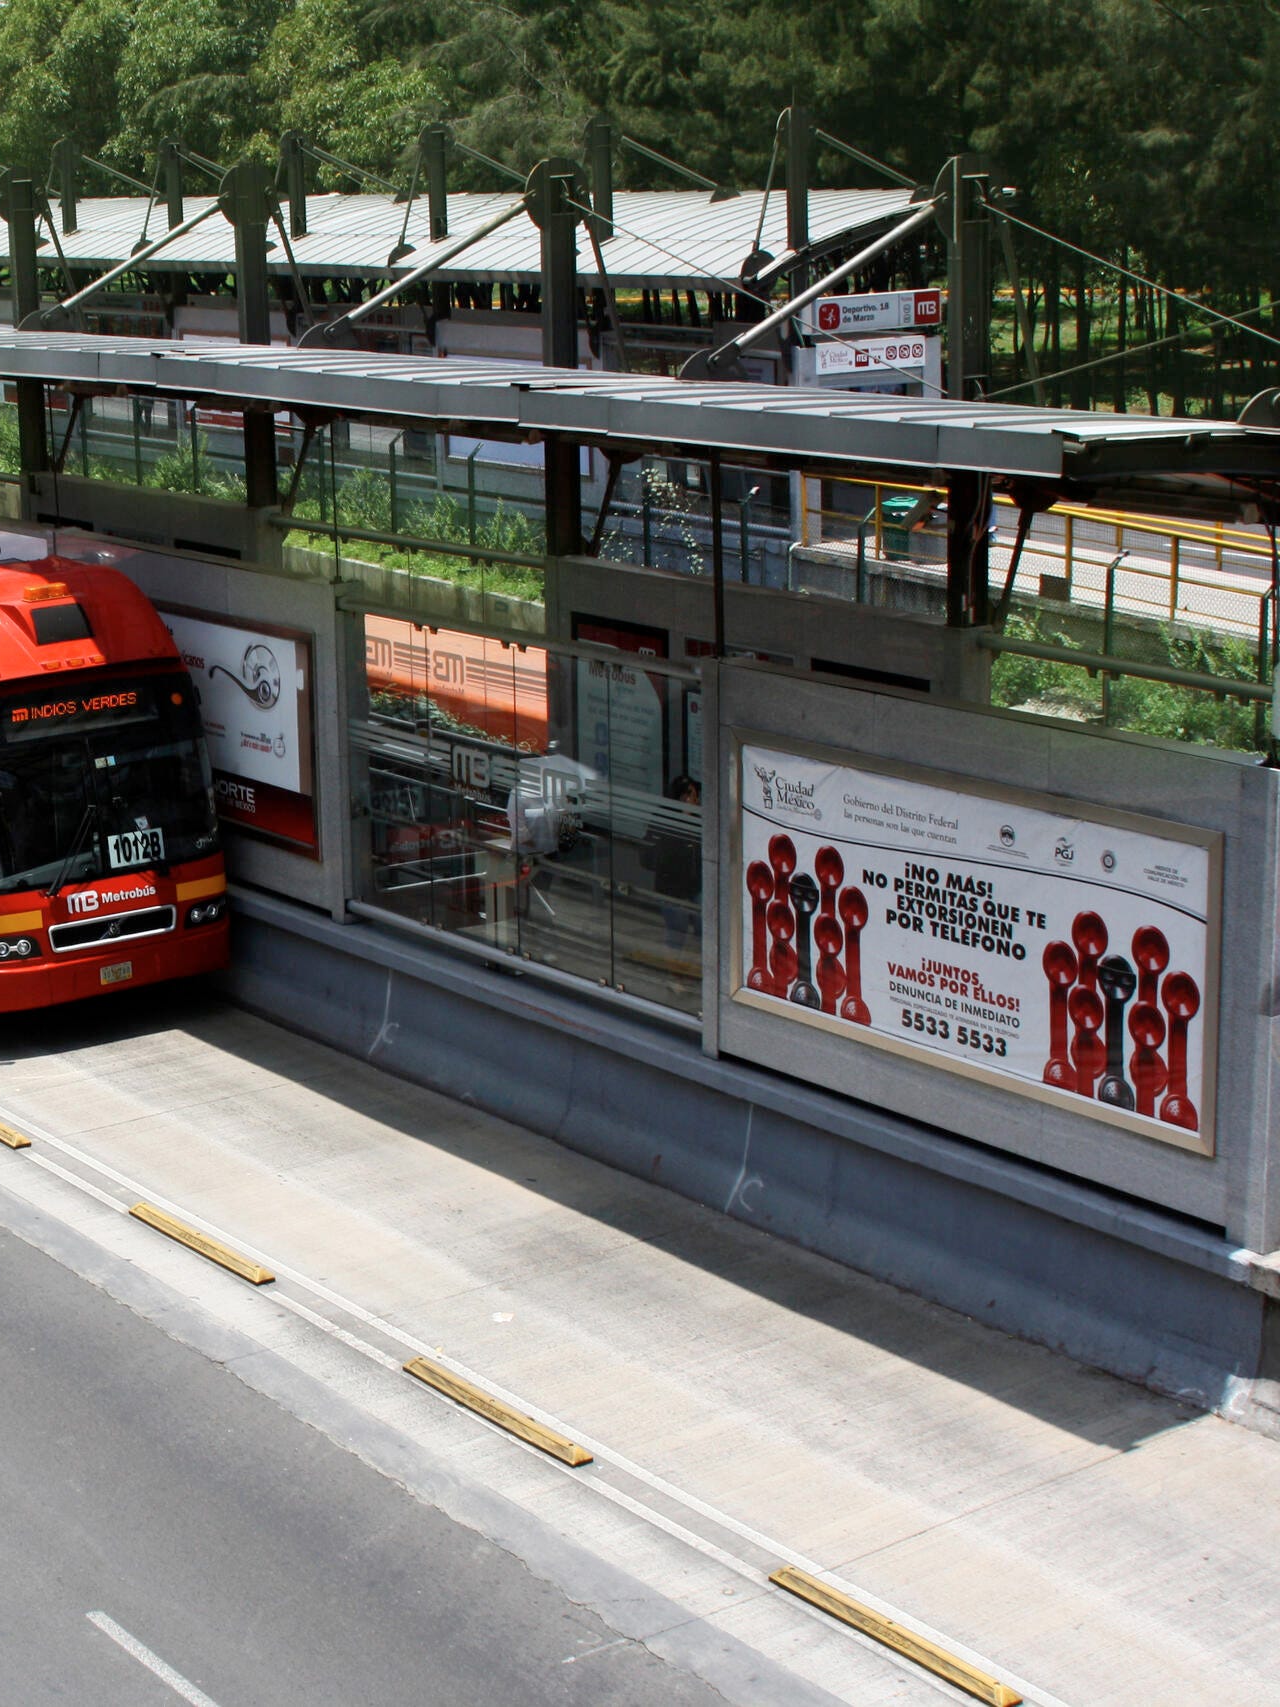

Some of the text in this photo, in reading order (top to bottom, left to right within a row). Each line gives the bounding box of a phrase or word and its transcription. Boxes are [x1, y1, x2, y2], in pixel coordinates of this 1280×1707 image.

[852, 314, 875, 322] Marzo
[31, 701, 77, 719] INDIOS
[82, 692, 137, 711] VERDES
[775, 776, 815, 797] Ciudad
[776, 791, 815, 811] México
[843, 794, 959, 831] Gobierno del Distrito Federal
[844, 808, 957, 845] las personas son las que cuentan
[1054, 847, 1074, 861] PGJ
[101, 884, 157, 904] Metrobús
[862, 869, 1047, 930] NO PERMITAS QUE TE
[904, 862, 994, 900] ¡NO MÁS!
[886, 908, 1026, 961] POR TELÉFONO
[896, 894, 1013, 940] EXTORSIONEN
[887, 961, 1020, 1012] VAMOS POR ELLOS!
[922, 957, 984, 988] ¡JUNTOS,
[888, 980, 1021, 1029] DENUNCIA DE INMEDIATO
[902, 1008, 1007, 1058] 5533 5533
